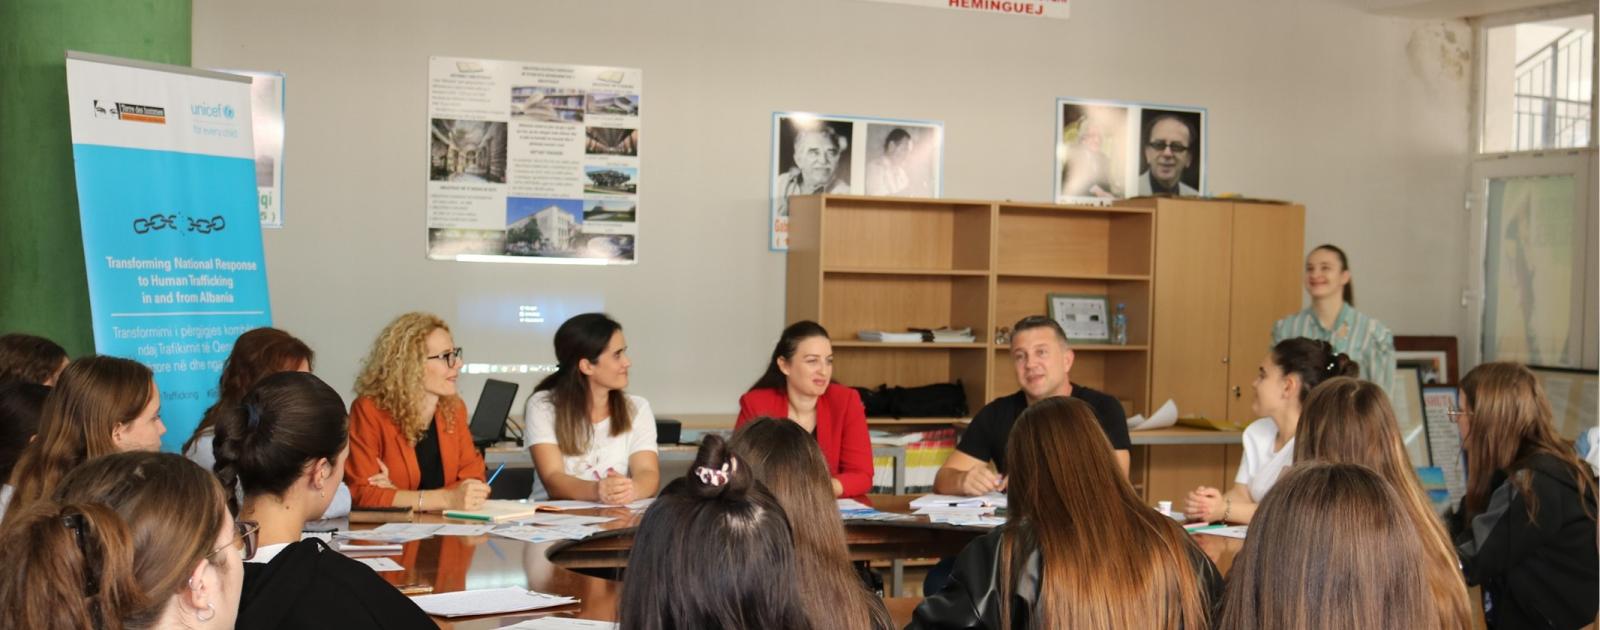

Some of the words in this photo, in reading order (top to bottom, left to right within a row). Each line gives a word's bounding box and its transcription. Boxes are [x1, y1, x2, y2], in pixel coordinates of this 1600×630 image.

[948, 0, 1044, 15] HEMINGUEJ
[191, 103, 221, 118] unicef
[106, 256, 172, 272] Transforming
[174, 256, 214, 270] National
[215, 258, 257, 272] Response
[138, 275, 149, 287] to
[151, 274, 188, 287] Human
[188, 274, 234, 289] Trafficking
[142, 291, 152, 304] in
[154, 291, 173, 304] and
[176, 291, 198, 304] from
[199, 291, 234, 304] Albania
[112, 326, 172, 339] Transformimi
[174, 359, 187, 372] në
[190, 358, 206, 371] dhe
